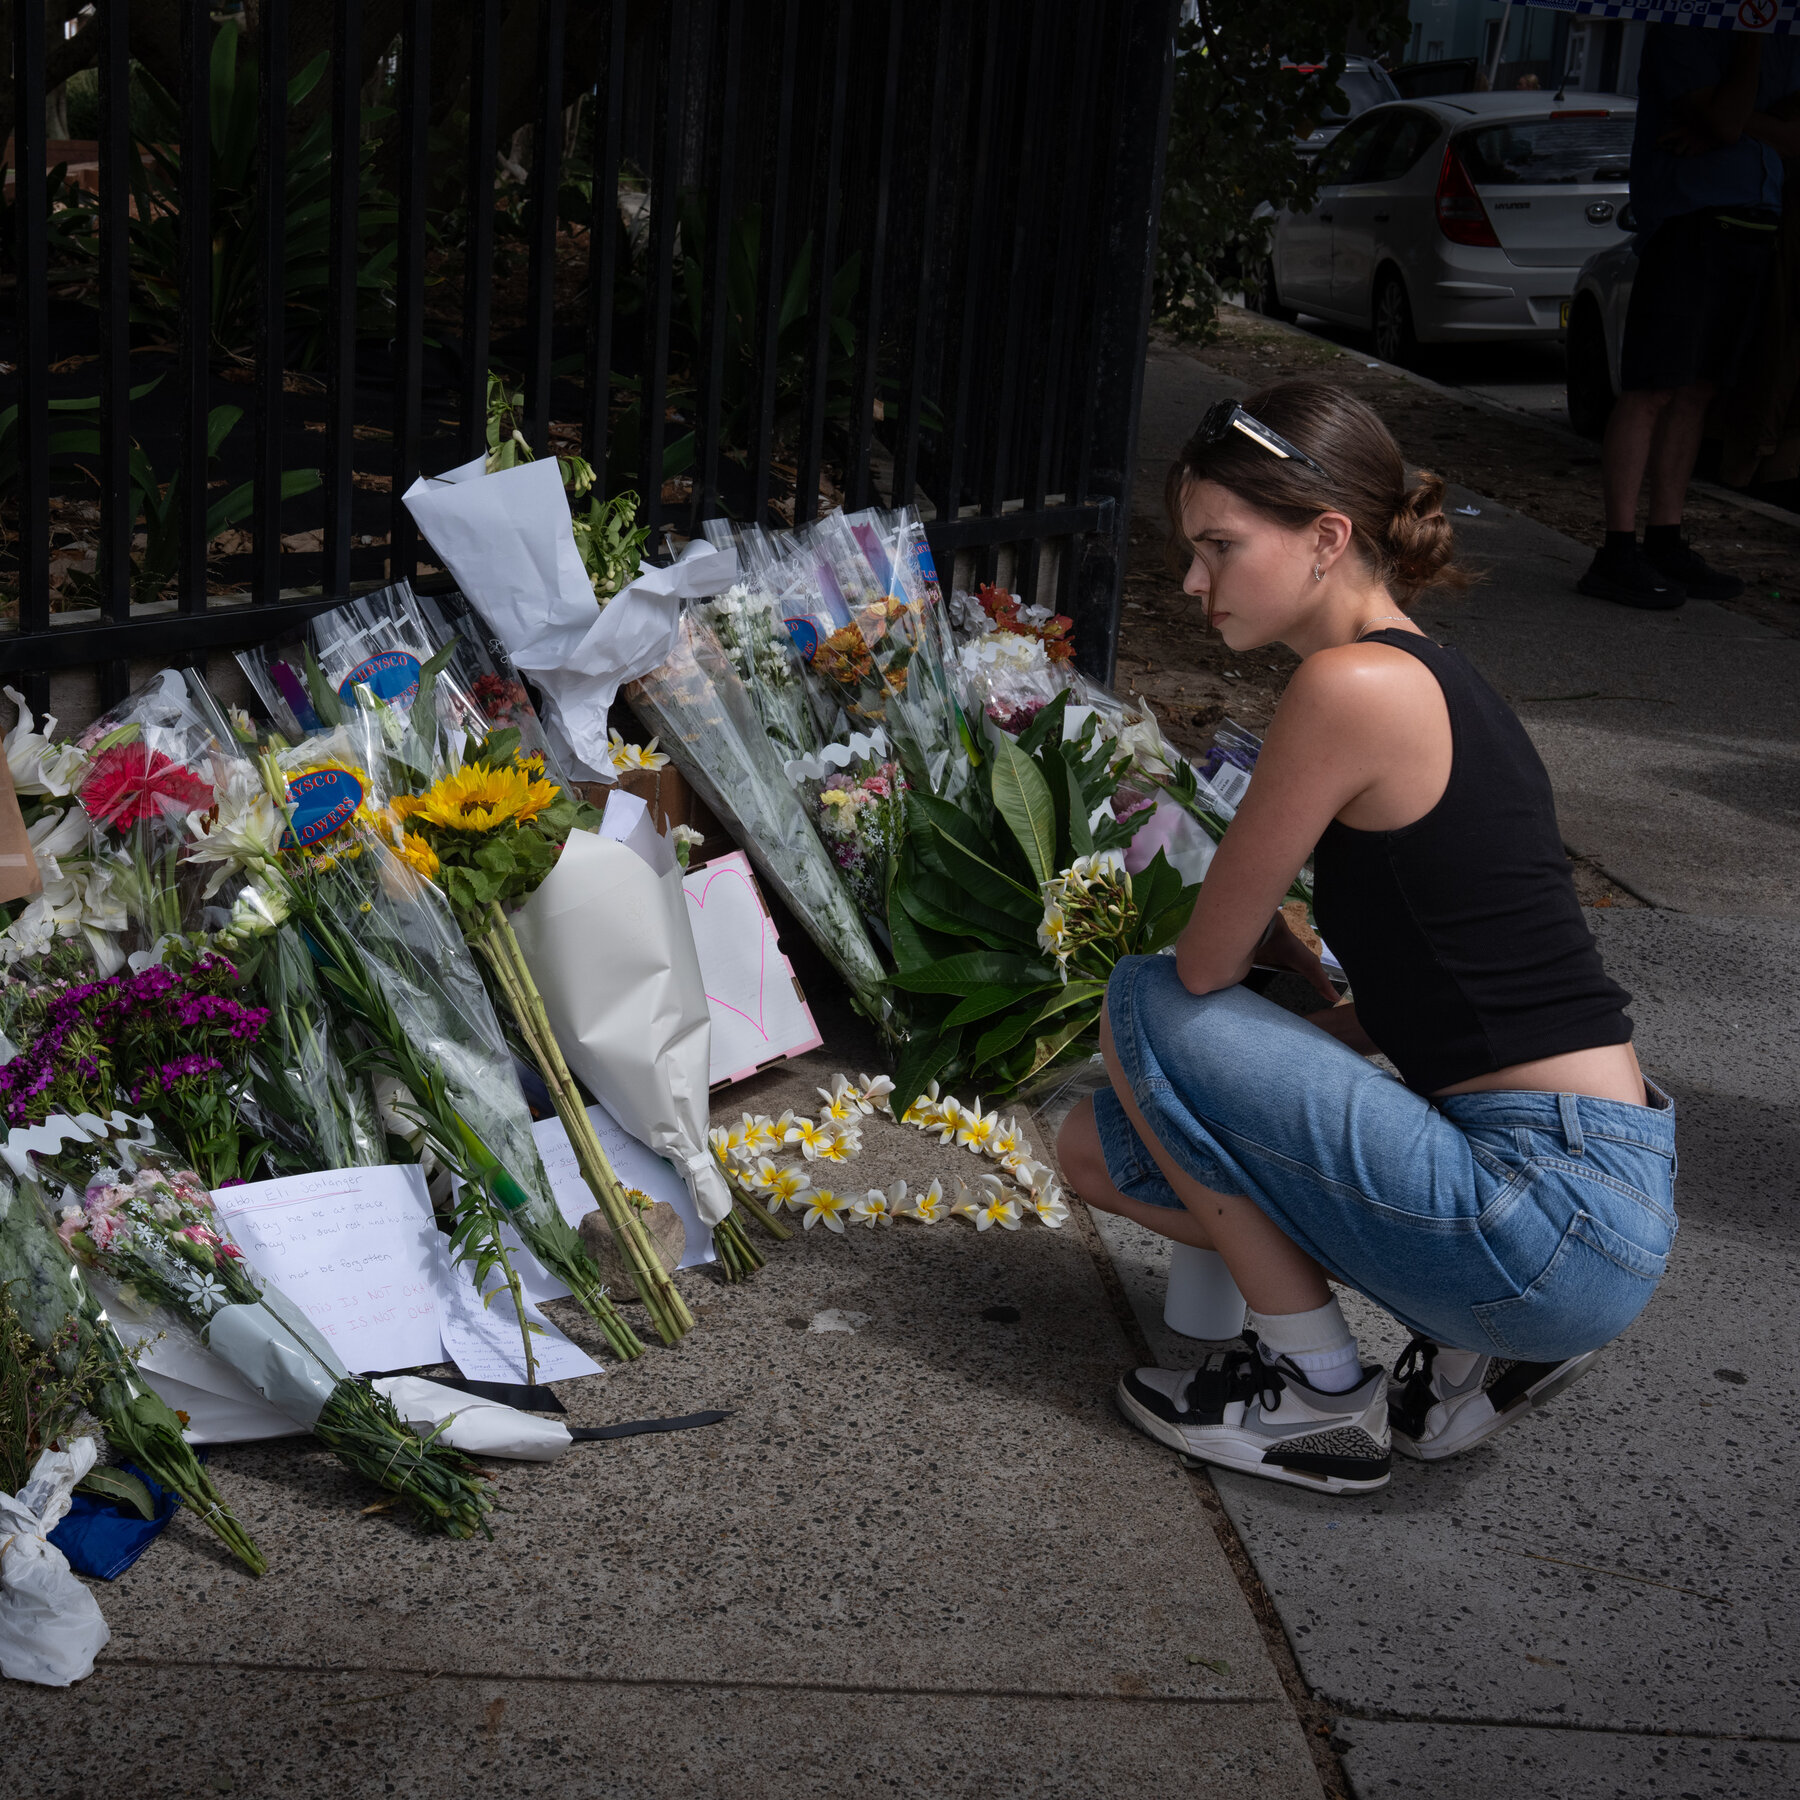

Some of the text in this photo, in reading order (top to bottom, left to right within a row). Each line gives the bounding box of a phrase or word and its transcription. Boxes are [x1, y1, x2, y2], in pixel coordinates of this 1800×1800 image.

[286, 773, 338, 803] RYSCO
[264, 1186, 290, 1202] Eli
[246, 1221, 282, 1236] May
[287, 1267, 310, 1280] not
[318, 1263, 335, 1274] be
[339, 1253, 393, 1272] forgotten
[336, 1295, 359, 1308] IS
[366, 1284, 393, 1300] NOT
[344, 1317, 368, 1332] IS
[372, 1307, 398, 1323] NOT
